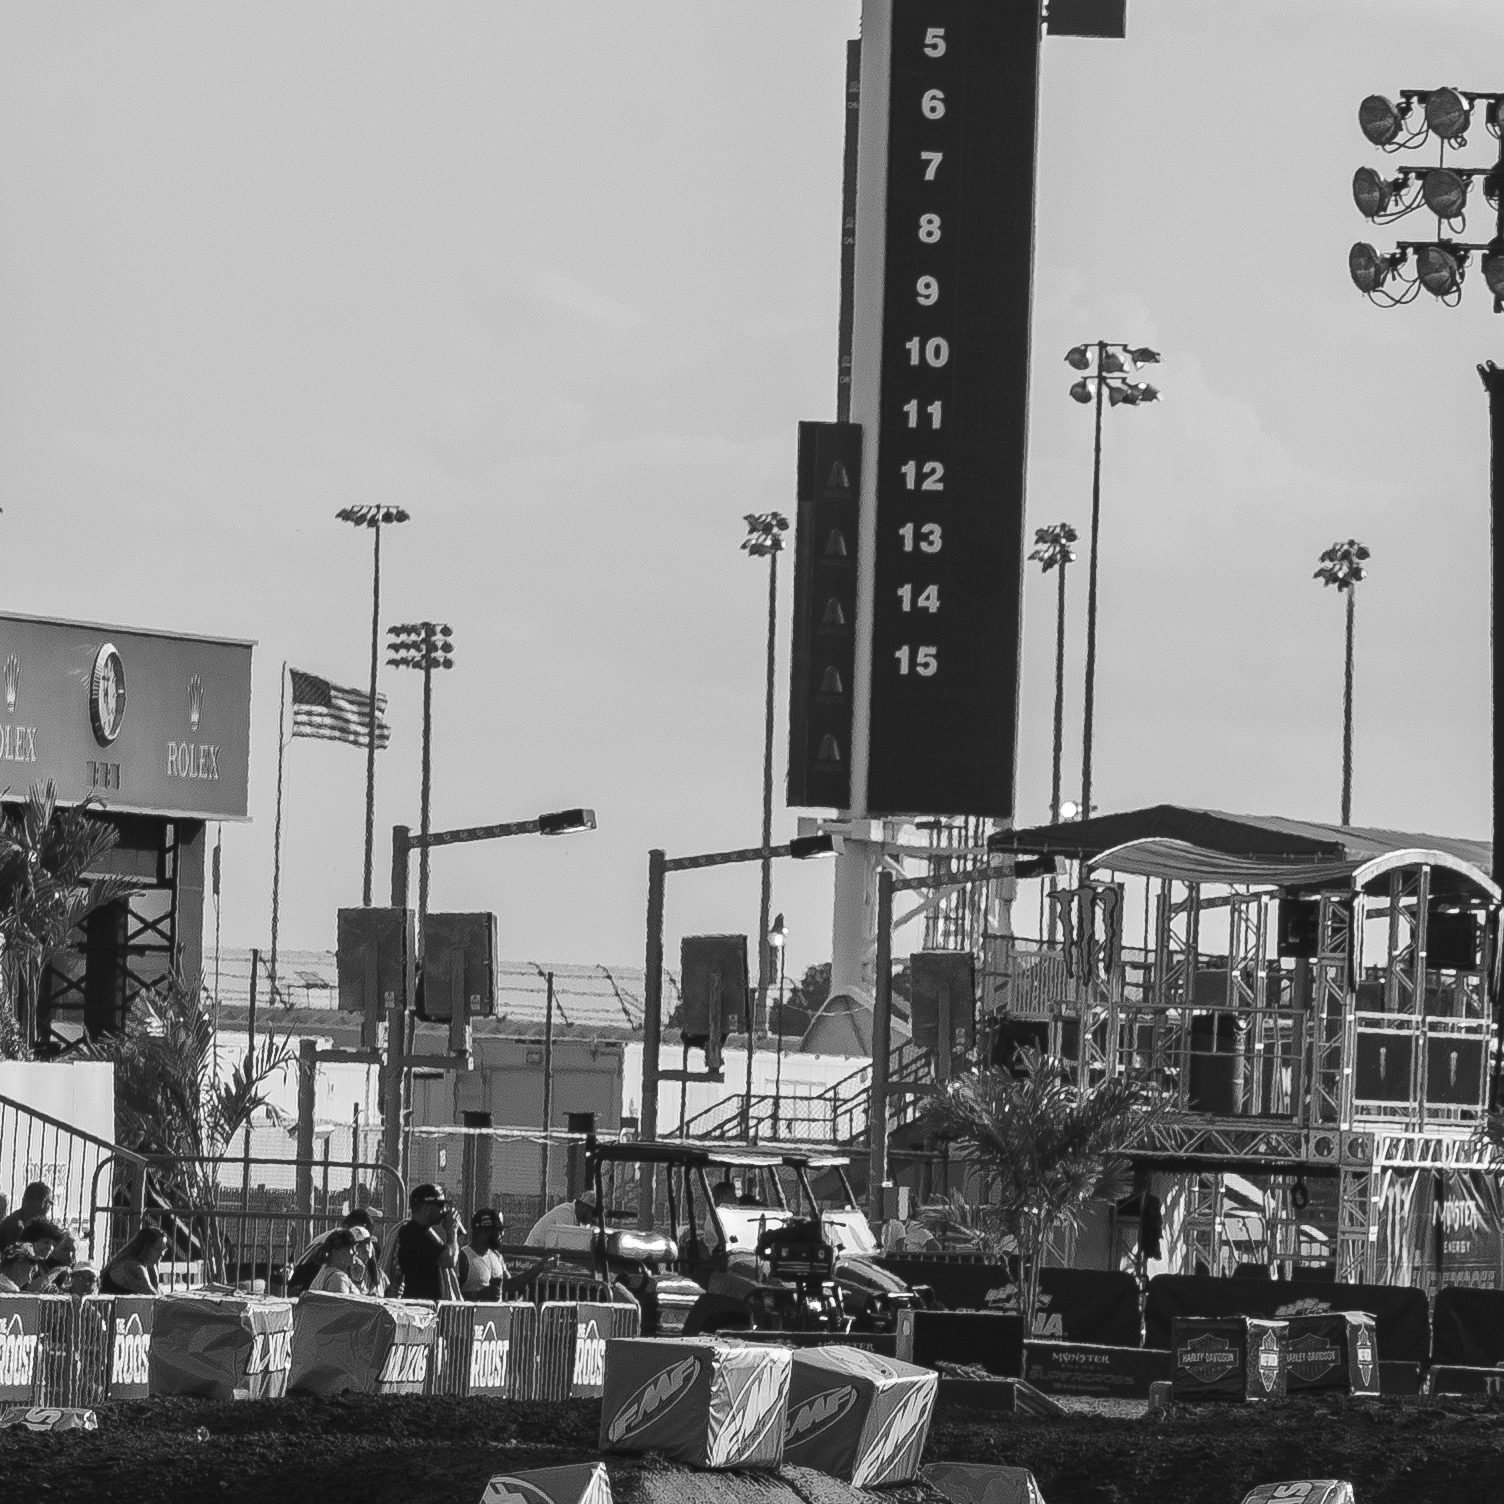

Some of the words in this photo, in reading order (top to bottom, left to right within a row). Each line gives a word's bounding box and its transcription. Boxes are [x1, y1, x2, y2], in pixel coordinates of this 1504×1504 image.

[924, 28, 946, 57] 5
[922, 89, 945, 119] 6
[921, 152, 943, 180] 7
[918, 213, 941, 244] 8
[916, 275, 939, 305] 9
[905, 337, 949, 367] 10
[904, 400, 943, 429] 11
[901, 461, 945, 491] 12
[898, 522, 943, 553] 13
[897, 584, 941, 613] 14
[895, 645, 939, 676] 15
[167, 741, 221, 781] ROLEX
[111, 1333, 151, 1385] ROOS
[469, 1339, 510, 1388] ROOST
[573, 1338, 606, 1386] ROOS
[1053, 1352, 1110, 1364] MONSTER
[609, 1355, 697, 1441] FMF
[786, 1384, 854, 1437] MF
